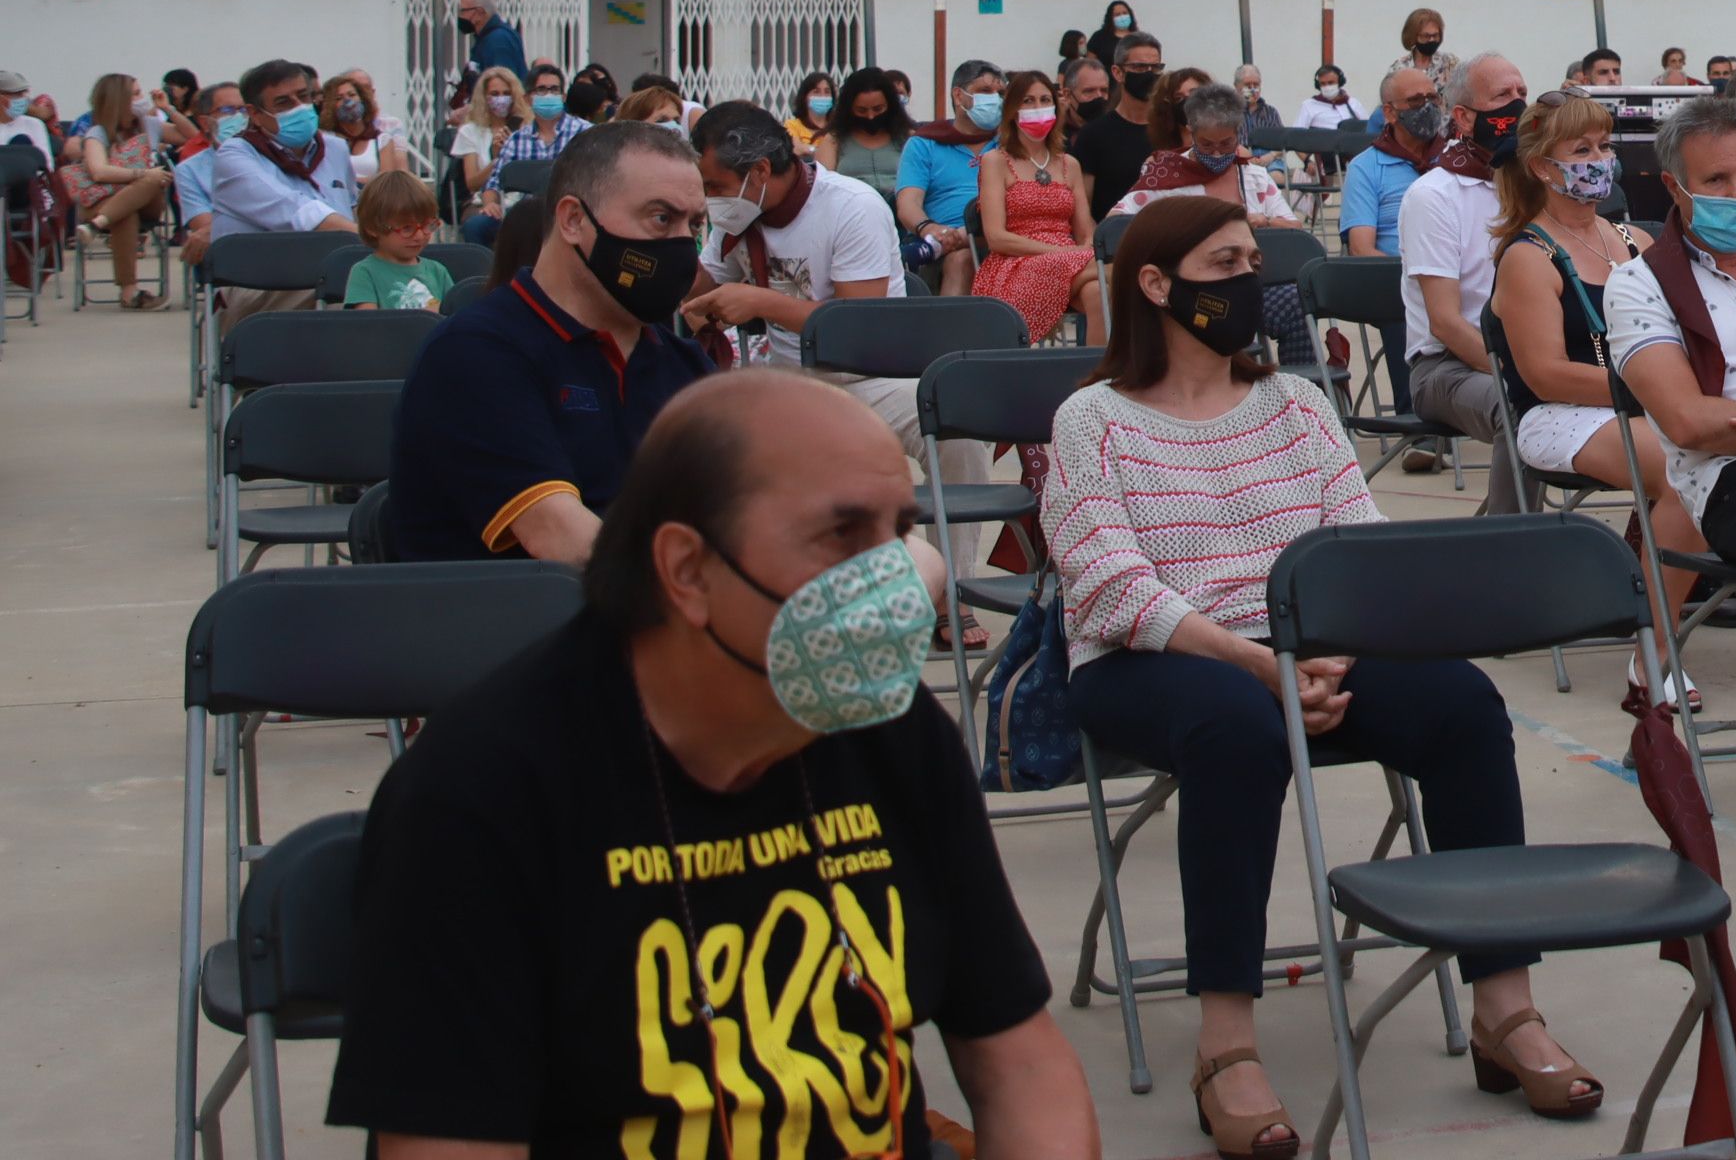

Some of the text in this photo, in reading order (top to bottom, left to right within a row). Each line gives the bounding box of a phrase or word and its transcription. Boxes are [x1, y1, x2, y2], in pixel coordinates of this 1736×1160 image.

[606, 803, 882, 888] POR TODA UNA VIDA
[817, 848, 893, 880] Gracias
